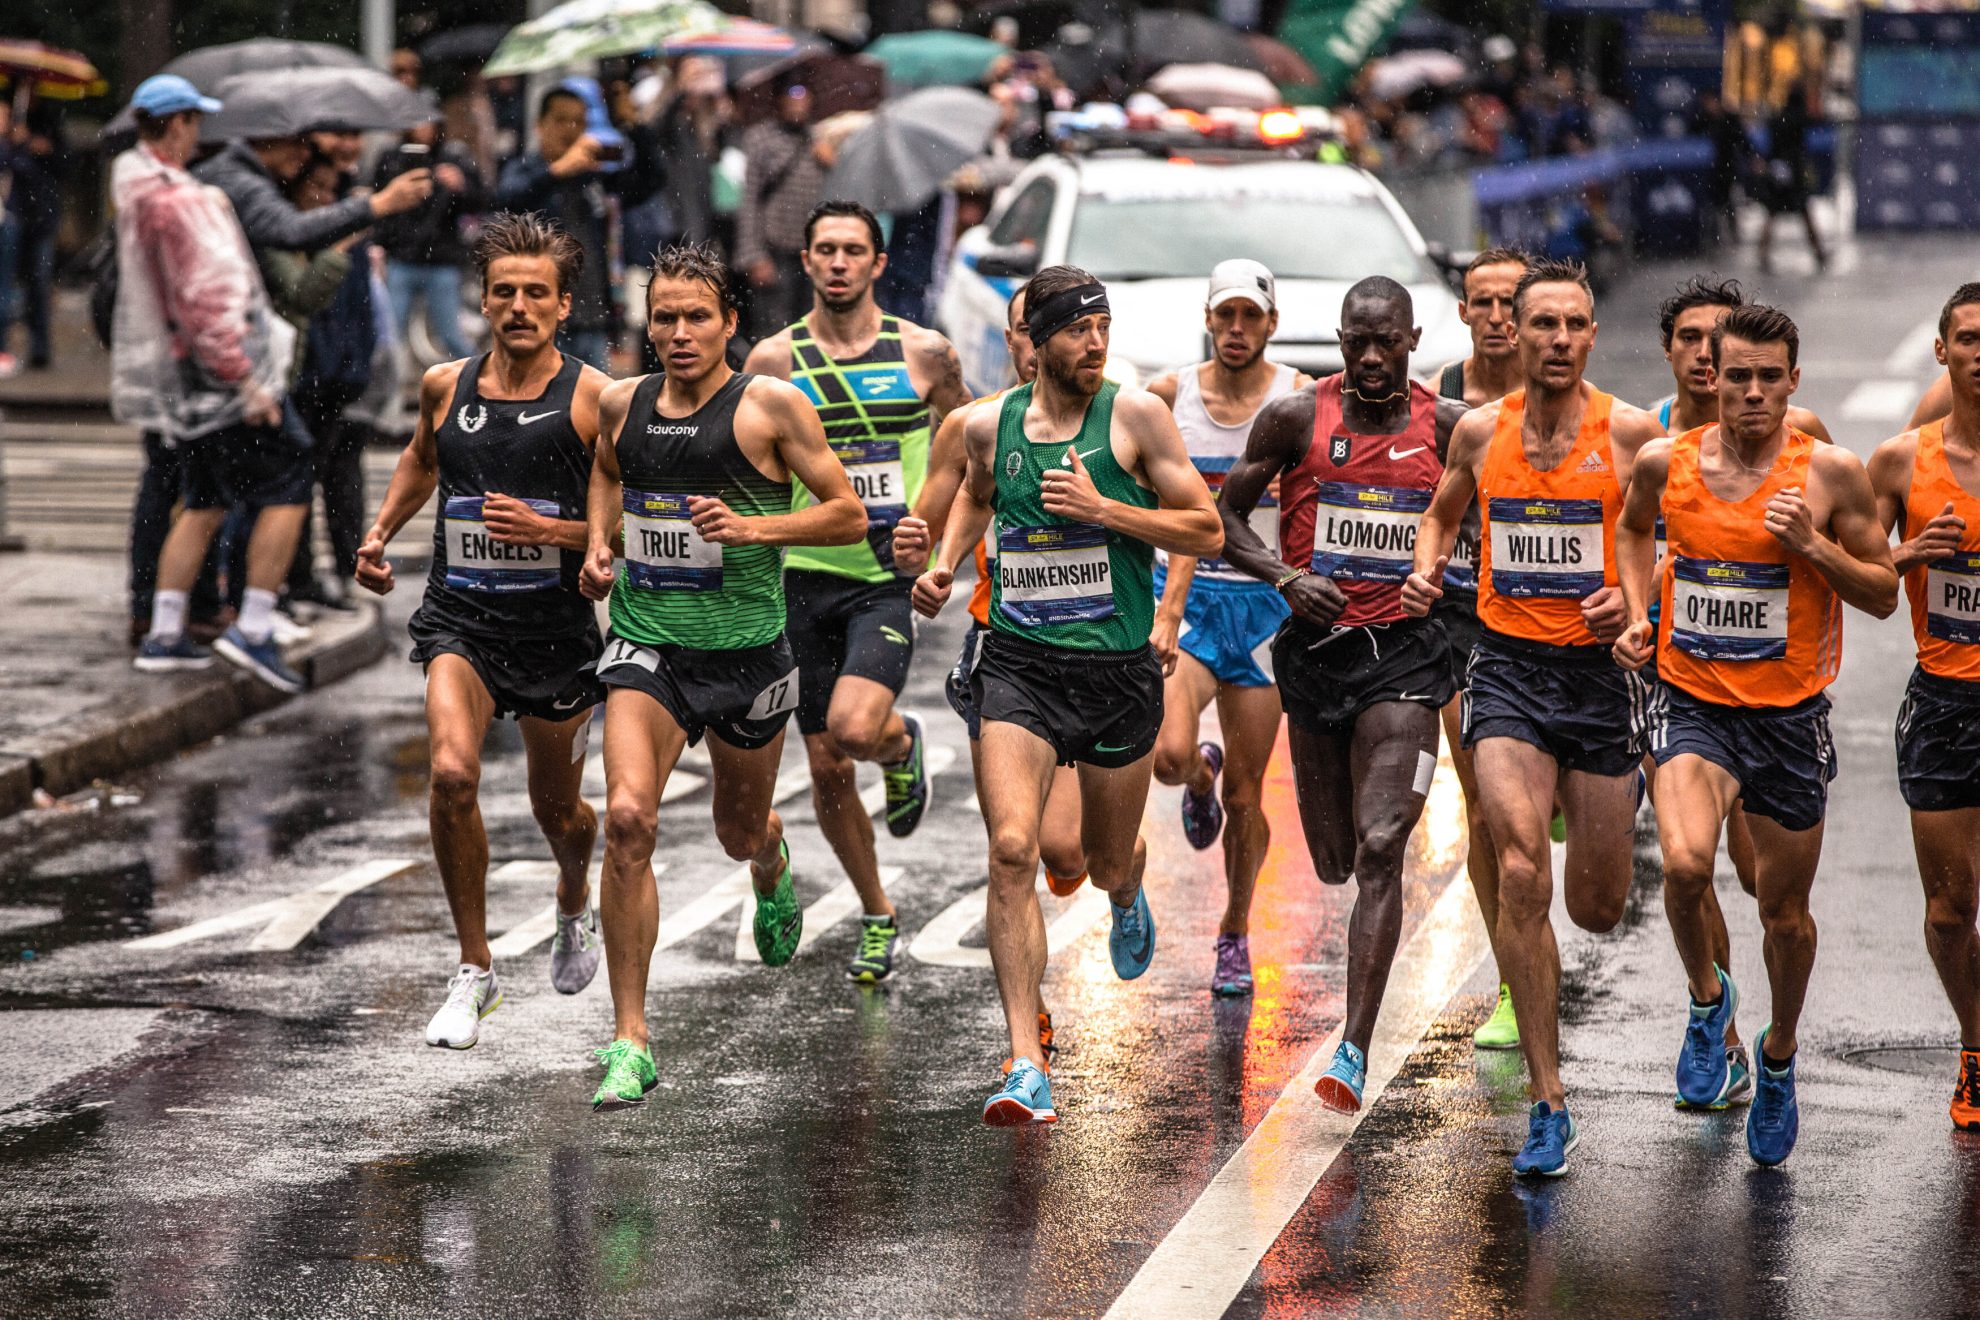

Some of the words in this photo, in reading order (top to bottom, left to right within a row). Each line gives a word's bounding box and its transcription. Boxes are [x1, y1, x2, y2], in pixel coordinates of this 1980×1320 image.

[848, 473, 891, 499] DLE
[461, 532, 543, 561] ENGELS
[640, 528, 691, 559] TRUE
[1326, 516, 1417, 553] LOMONG
[1508, 534, 1583, 565] WILLIS
[1002, 561, 1109, 589] BLANKENSHIP
[1687, 594, 1769, 629] O'HARE
[610, 640, 639, 663] 17
[764, 680, 790, 716] 17
